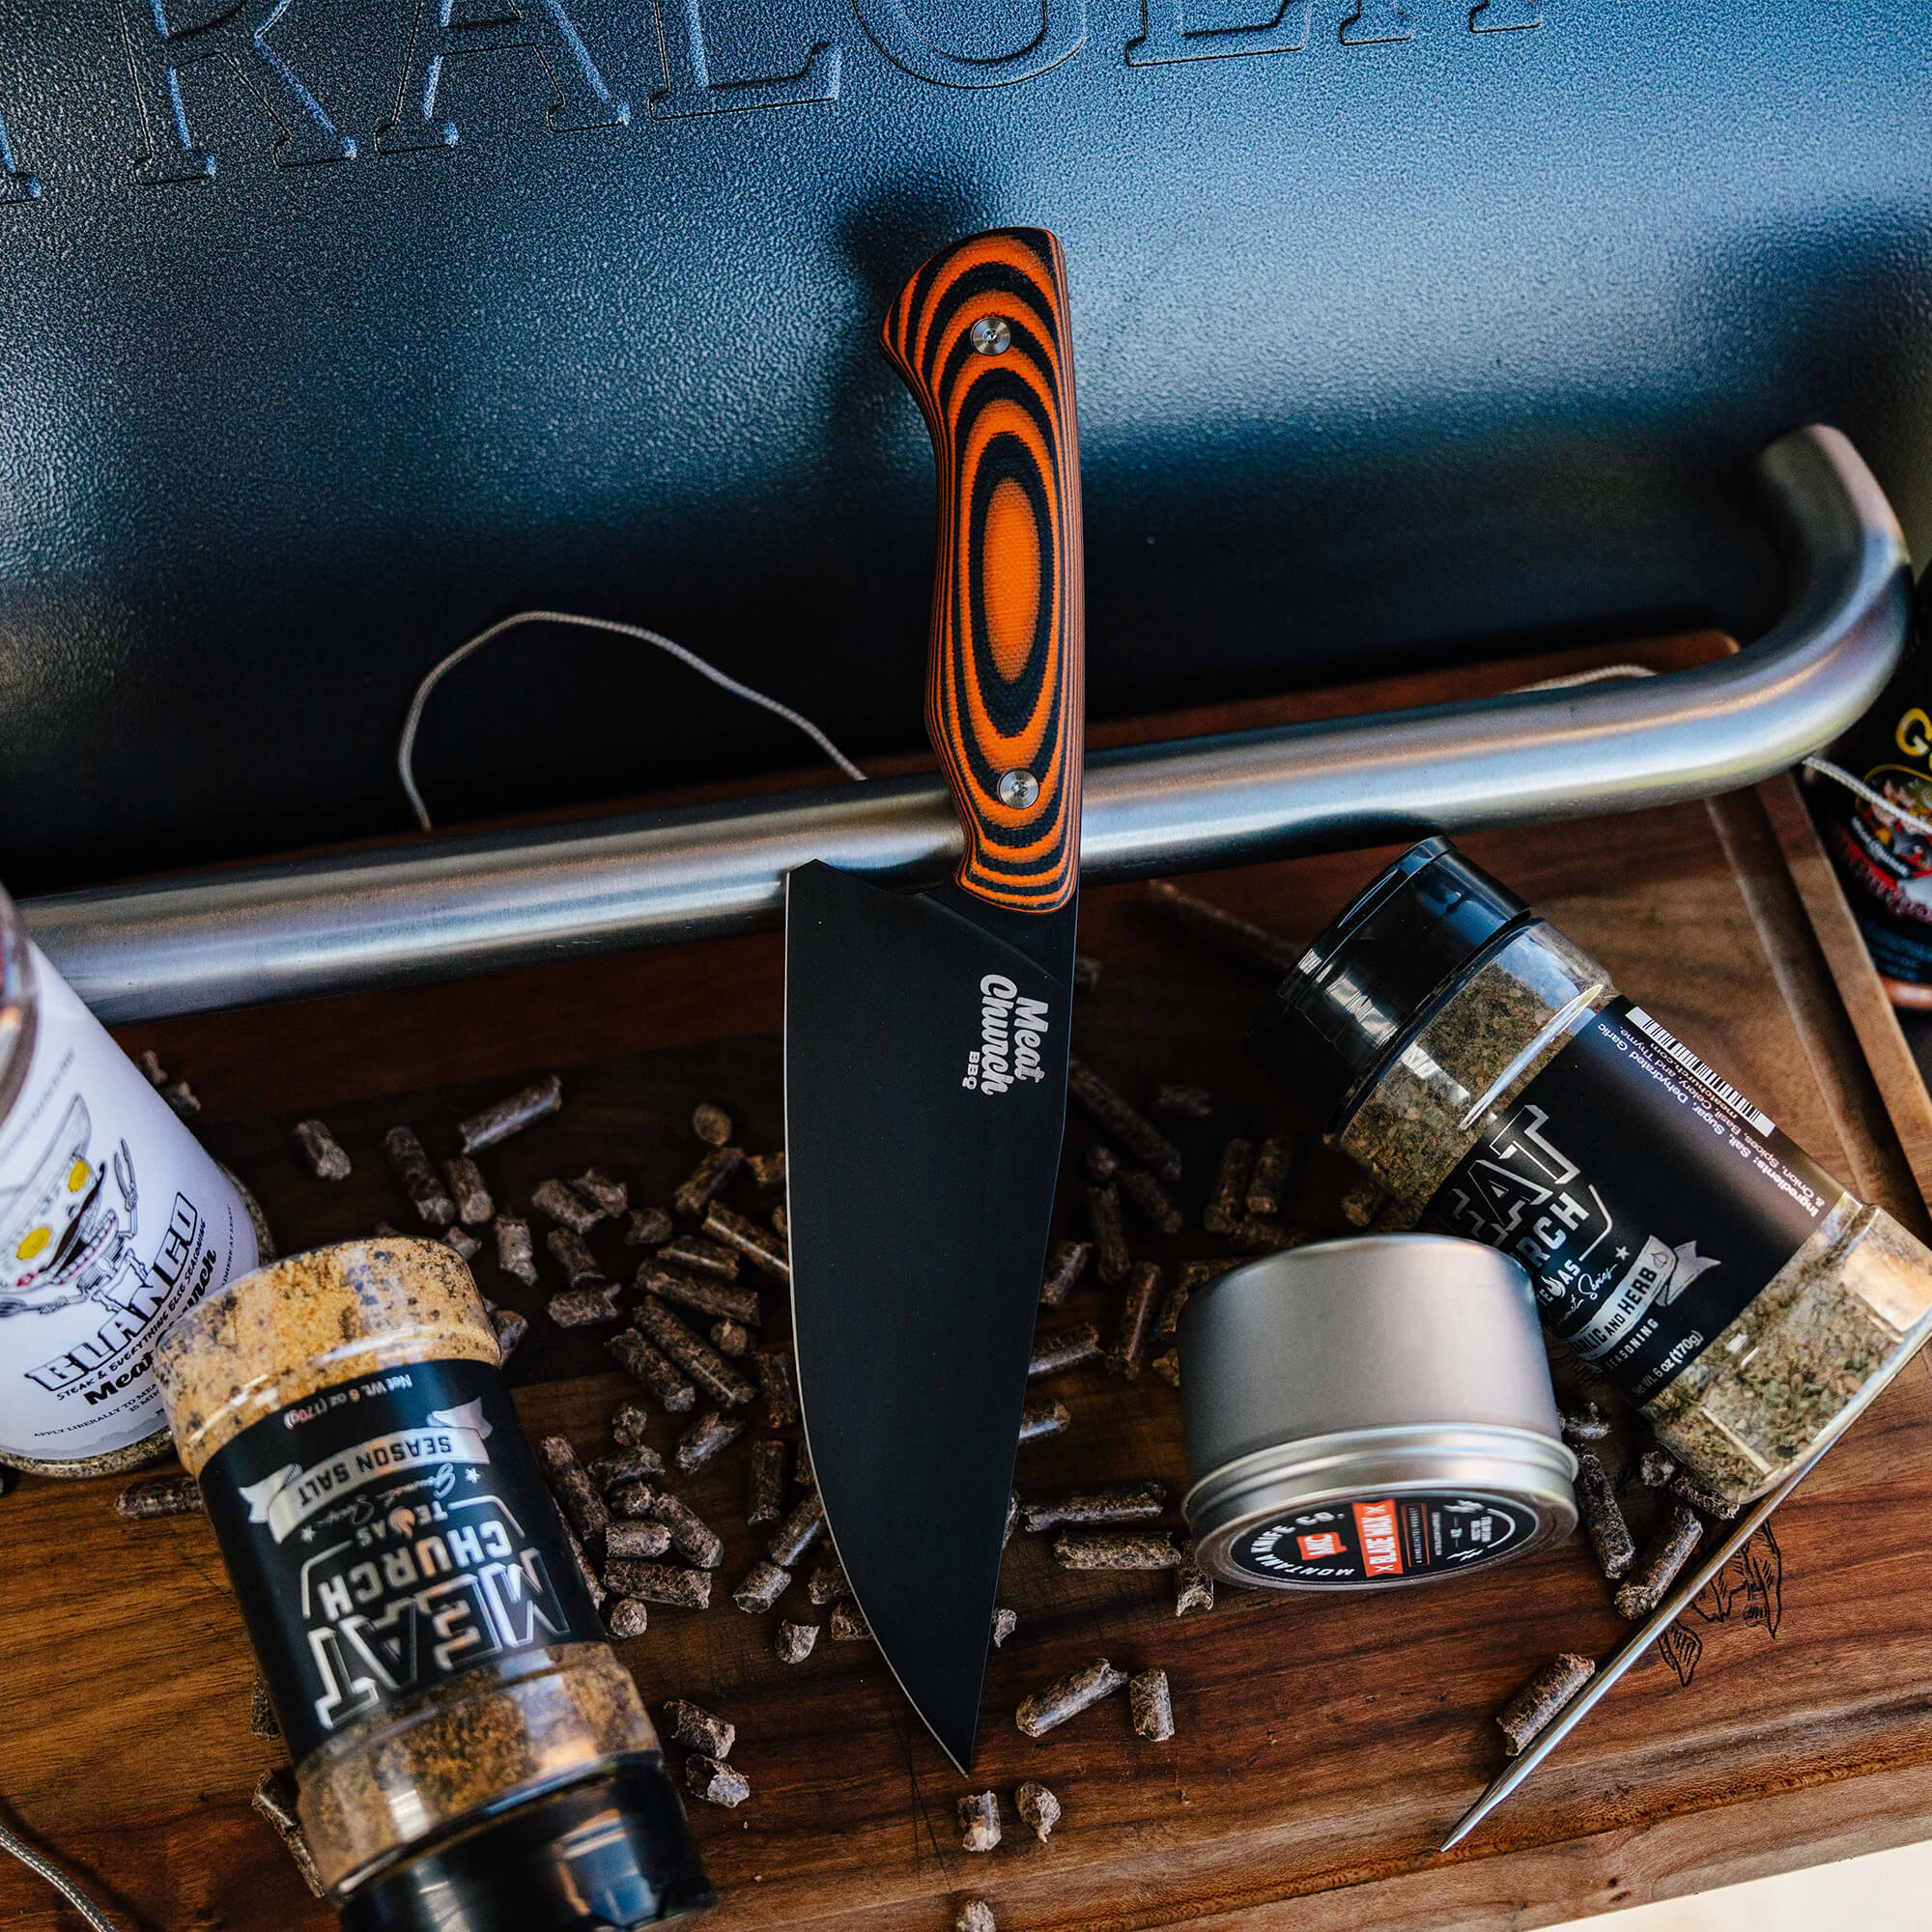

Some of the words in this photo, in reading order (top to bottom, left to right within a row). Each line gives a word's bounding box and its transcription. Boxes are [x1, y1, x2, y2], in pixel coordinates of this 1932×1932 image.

[980, 974, 1018, 1095] Church
[1013, 996, 1049, 1083] Meat
[1598, 1023, 1628, 1051] Garlic
[1620, 1026, 1654, 1062] Thyme.
[962, 1050, 980, 1090] BBQ
[1629, 1051, 1689, 1103] Dehydrated
[1650, 1042, 1739, 1120] meatchurch.com
[1655, 1060, 1676, 1078] and
[1691, 1102, 1725, 1135] Sugar,
[1728, 1133, 1751, 1158] Salt,
[1452, 1104, 1581, 1246] EAT
[1752, 1156, 1819, 1217] Ingredients:
[1781, 1165, 1814, 1198] Onion,
[1815, 1196, 1825, 1208] &
[1515, 1191, 1590, 1267] RCH
[24, 1191, 198, 1391] BLANCO
[1537, 1259, 1581, 1307] TEAS
[1577, 1264, 1618, 1299] Series
[56, 1378, 95, 1401] STEAK
[98, 1370, 108, 1380] &
[109, 1311, 169, 1372] EVERYTHING
[168, 1283, 186, 1312] ELSE
[184, 1217, 206, 1286] SEASONING
[1605, 1313, 1626, 1337] AND
[1617, 1267, 1658, 1316] HERB
[1605, 1318, 1660, 1370] SEASONING
[1653, 1367, 1663, 1379] 6
[1660, 1357, 1675, 1373] oz
[1668, 1329, 1704, 1365] (170g)
[83, 1350, 154, 1406] Meat
[140, 1389, 160, 1406] MIN
[348, 1388, 360, 1403] 6
[385, 1374, 412, 1392] Net
[34, 1428, 65, 1437] APPLY
[68, 1407, 122, 1432] LIBERALLY
[121, 1398, 136, 1409] TO
[136, 1383, 157, 1400] MEA
[283, 1397, 328, 1430] (170g)
[355, 1435, 453, 1474] SEASON
[298, 1462, 352, 1506] SALT
[355, 1500, 449, 1547] TEAS
[1295, 1511, 1345, 1526] CO.
[1360, 1514, 1394, 1538] WAX
[1250, 1524, 1297, 1554] KNIFE
[1304, 1533, 1336, 1556] MKC
[1365, 1536, 1398, 1565] BLADE
[317, 1520, 513, 1621] CHURCH
[1255, 1553, 1355, 1577] MONTANA
[307, 1547, 571, 1730] MEAT
